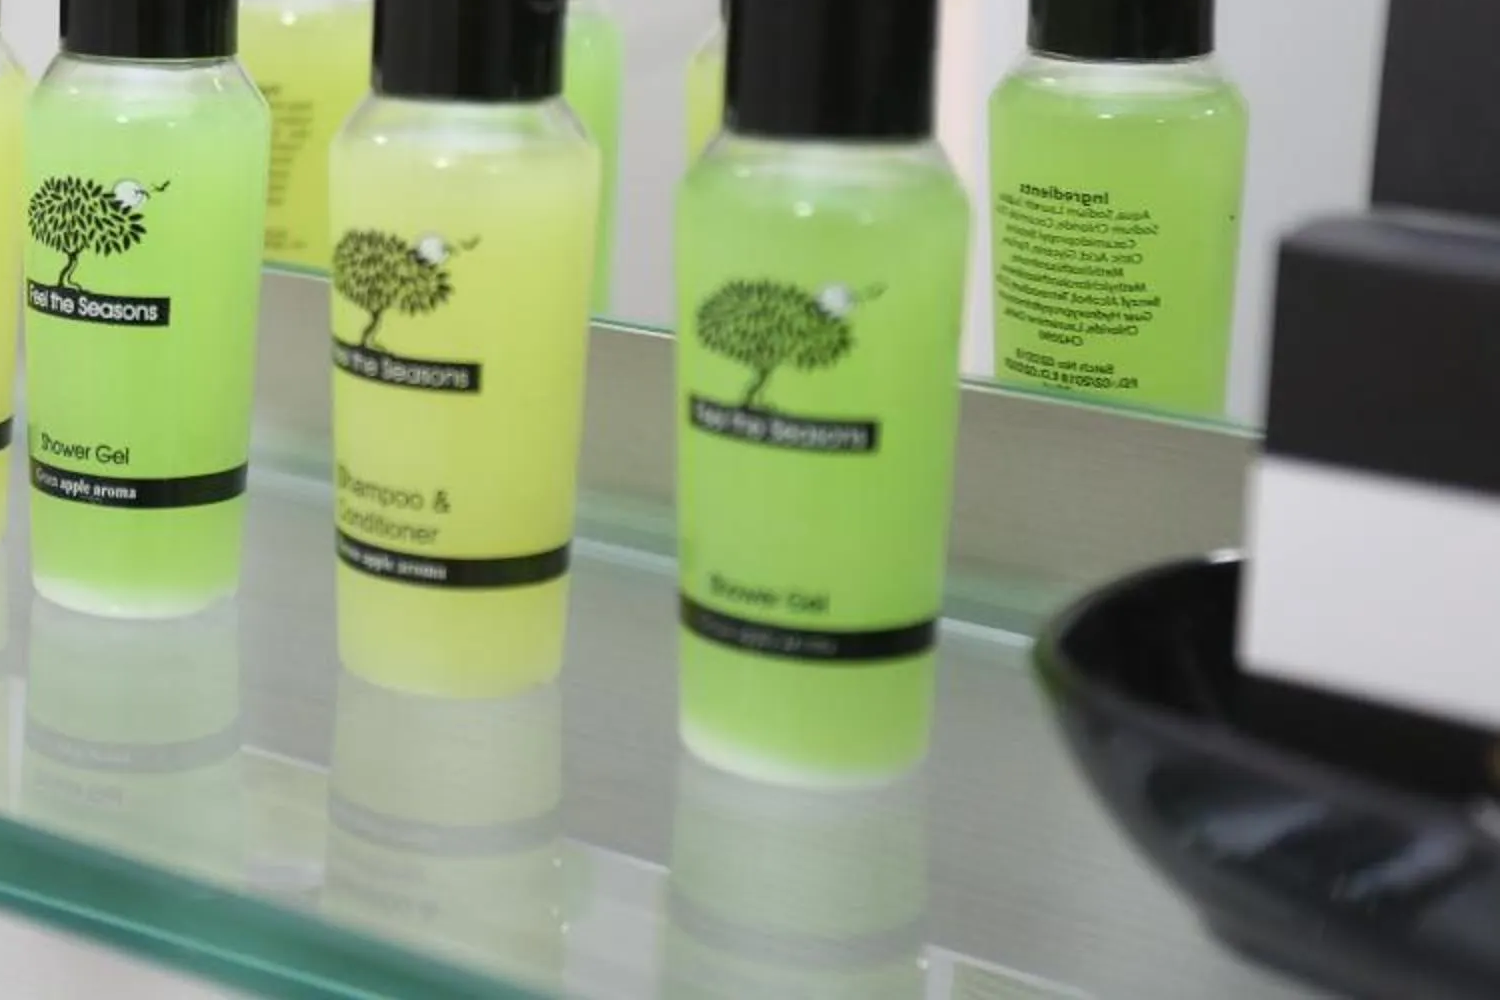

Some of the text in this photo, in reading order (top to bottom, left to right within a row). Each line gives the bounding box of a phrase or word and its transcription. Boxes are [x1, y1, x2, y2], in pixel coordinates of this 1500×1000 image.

[50, 291, 75, 314] the
[77, 295, 159, 321] Seasons
[379, 356, 470, 389] Seasons
[40, 431, 131, 466] Shower Gel
[769, 417, 870, 450] Seasons
[59, 475, 91, 497] apple
[93, 484, 138, 500] aroma
[433, 488, 451, 514] &
